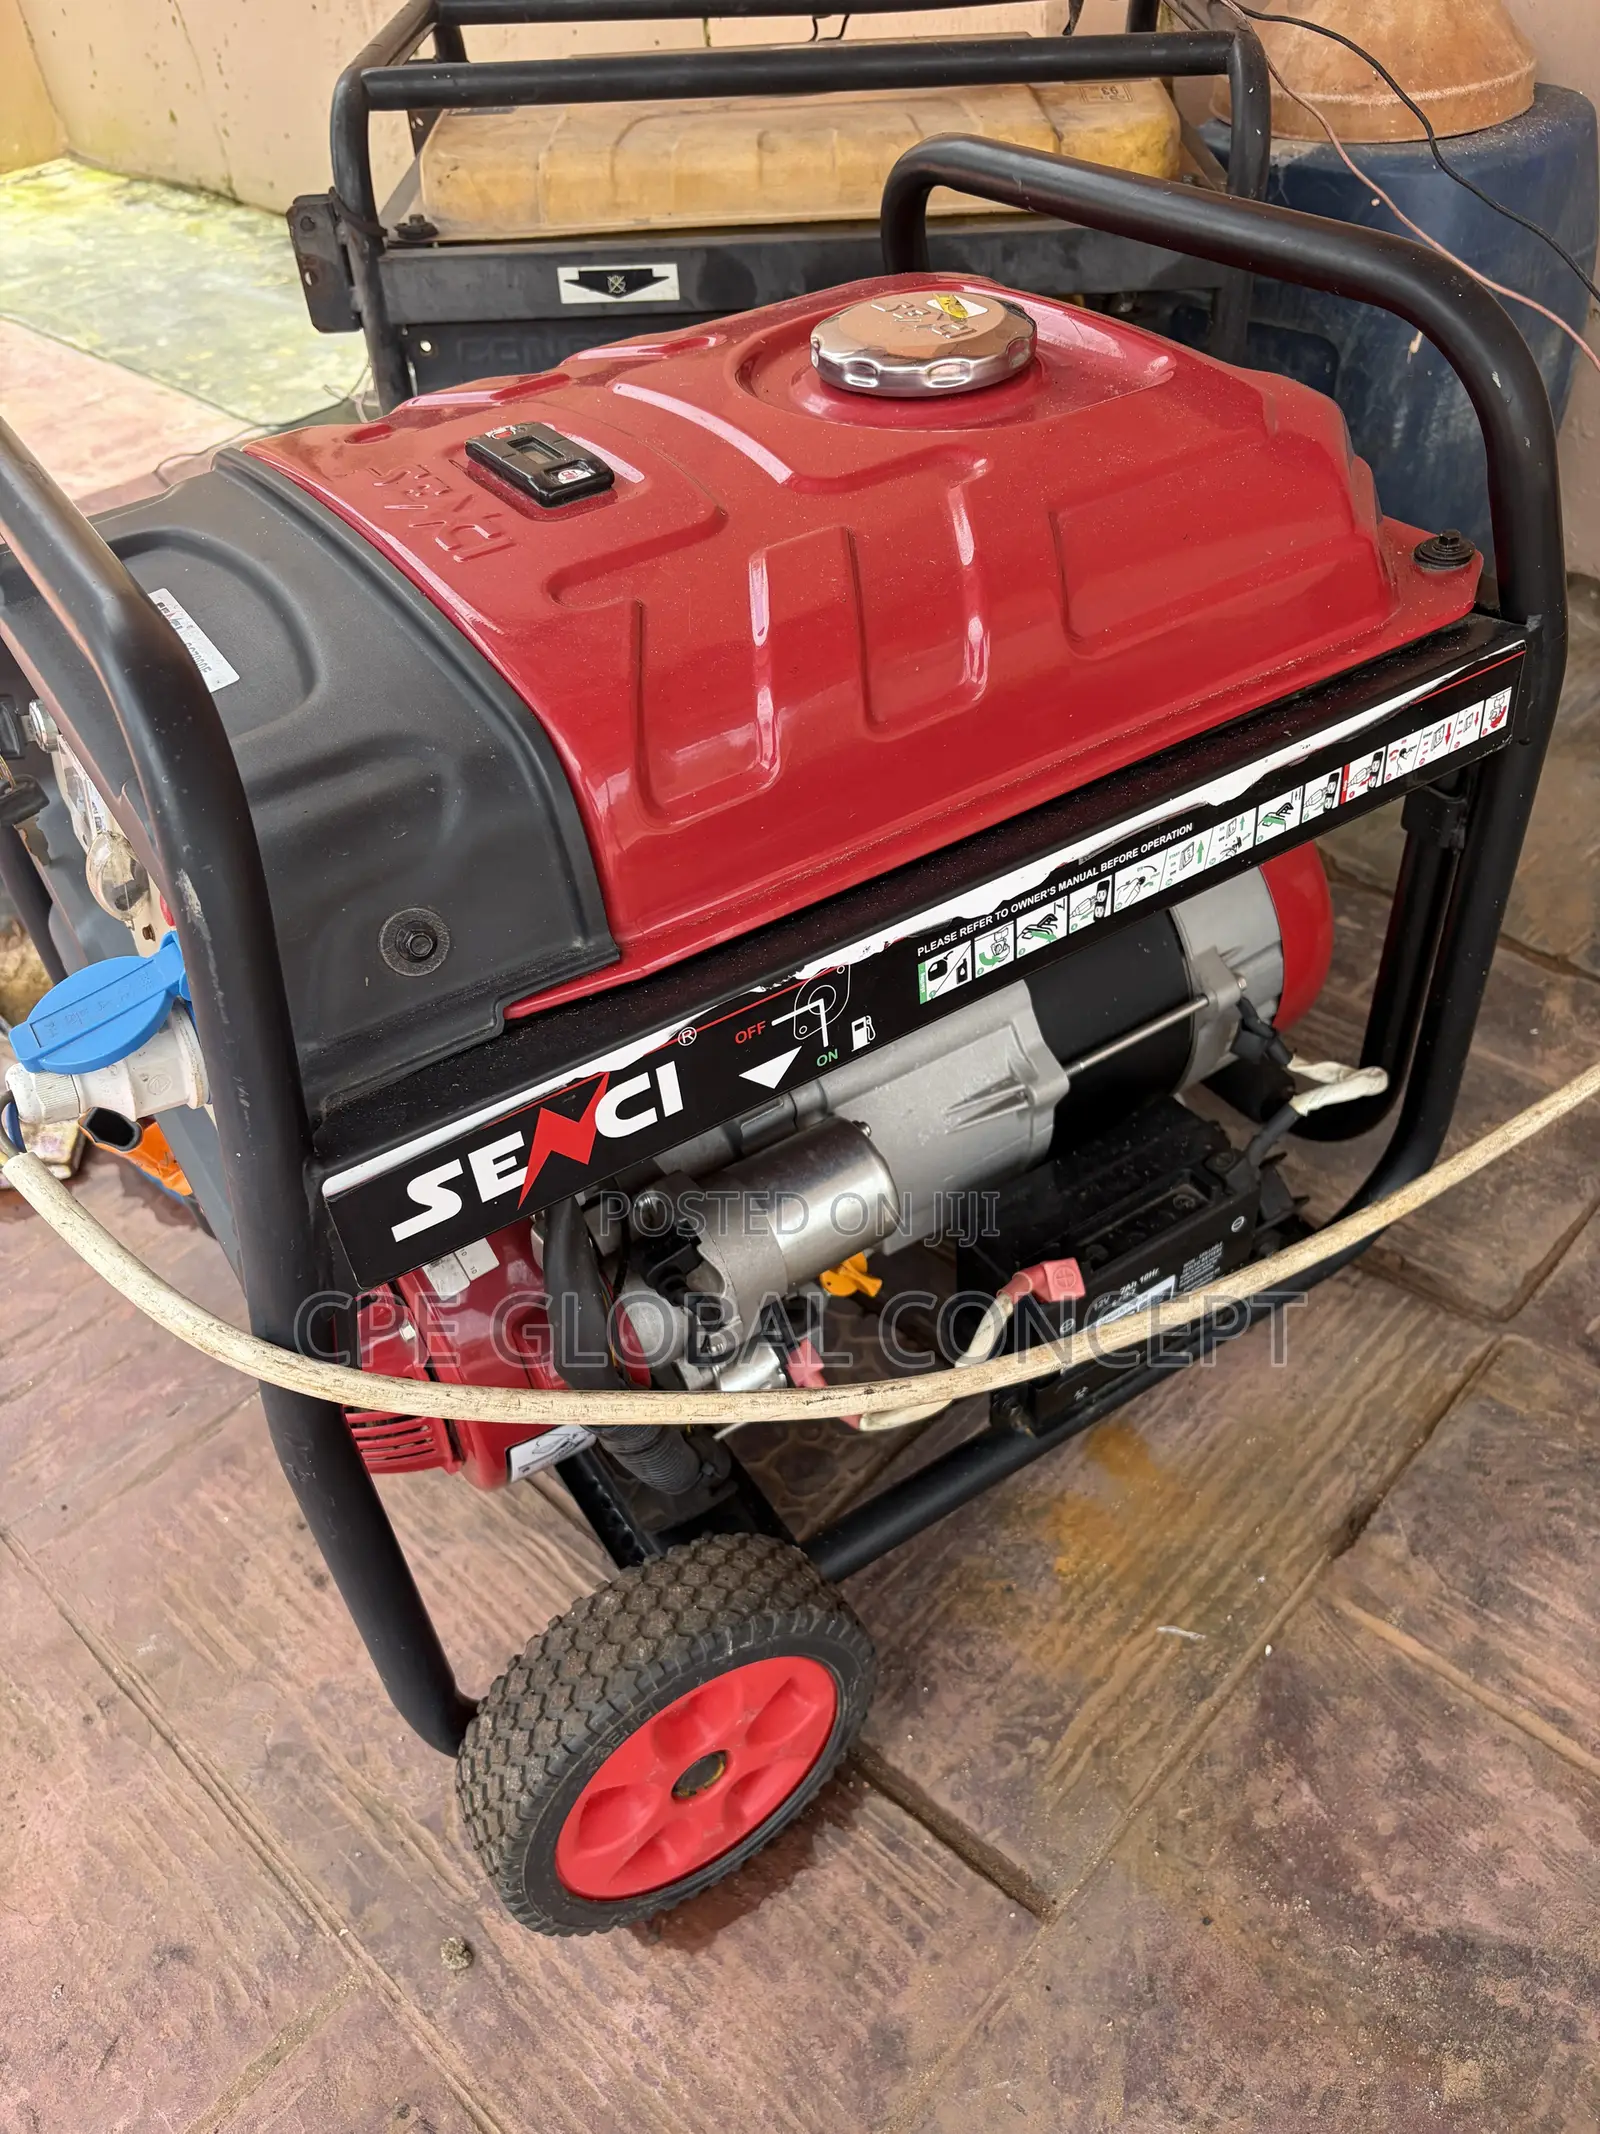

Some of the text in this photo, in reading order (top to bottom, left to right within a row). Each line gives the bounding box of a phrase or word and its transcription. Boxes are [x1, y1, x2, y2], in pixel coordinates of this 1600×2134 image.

[917, 822, 1193, 957] PLEASE REFER TO OWNER'S MANUAL BEFORE OPERATION
[734, 1020, 767, 1044] OFF
[816, 1048, 839, 1067] ON
[390, 1060, 685, 1243] SENCI
